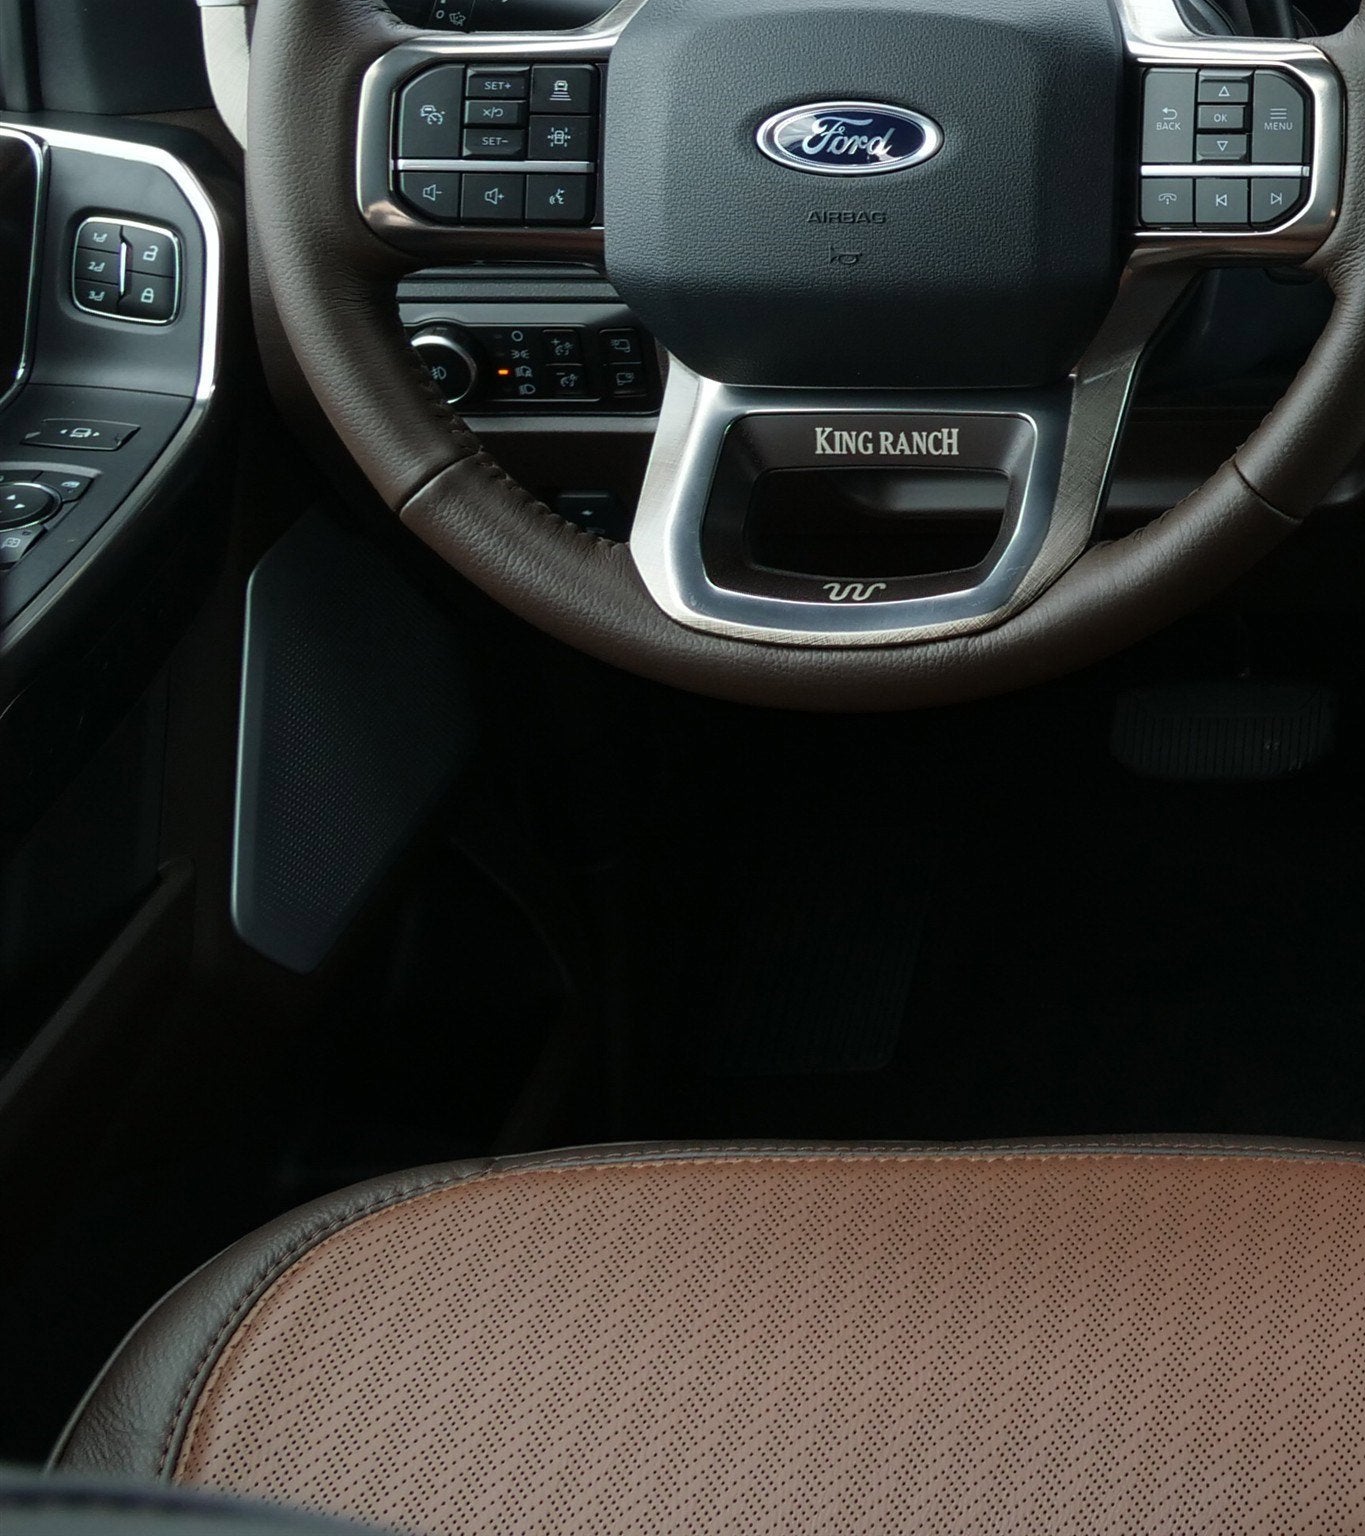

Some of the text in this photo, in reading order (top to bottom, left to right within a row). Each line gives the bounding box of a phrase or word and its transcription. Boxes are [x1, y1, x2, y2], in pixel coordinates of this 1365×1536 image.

[484, 81, 512, 90] SET+
[1214, 114, 1228, 123] OK
[1156, 121, 1182, 131] BACK
[1264, 122, 1294, 132] MENU
[802, 116, 896, 156] Ford
[807, 210, 887, 224] AIRBAG
[814, 426, 960, 456] KING RANCH
